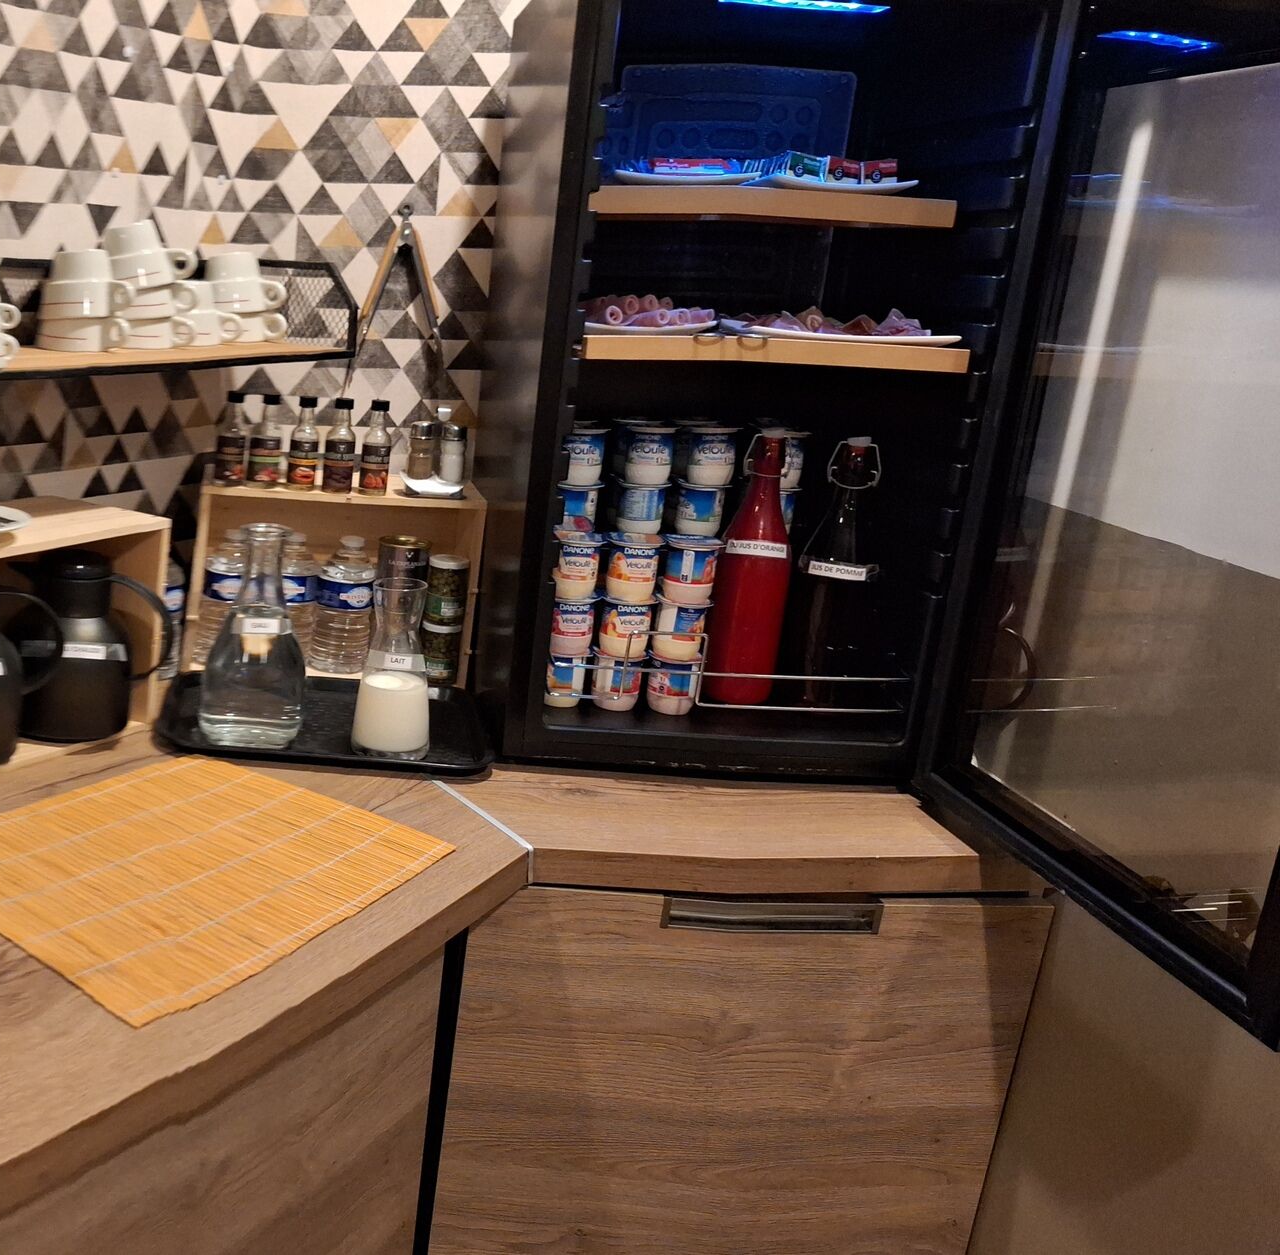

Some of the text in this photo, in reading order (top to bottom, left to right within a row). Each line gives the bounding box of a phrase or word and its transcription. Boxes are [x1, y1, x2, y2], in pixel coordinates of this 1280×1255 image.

[563, 545, 596, 555] DANONE
[624, 547, 656, 556] DANONE
[811, 563, 823, 572] JUS
[836, 567, 865, 577] POMME
[560, 603, 591, 612] DANONE
[617, 605, 649, 613] DANONE
